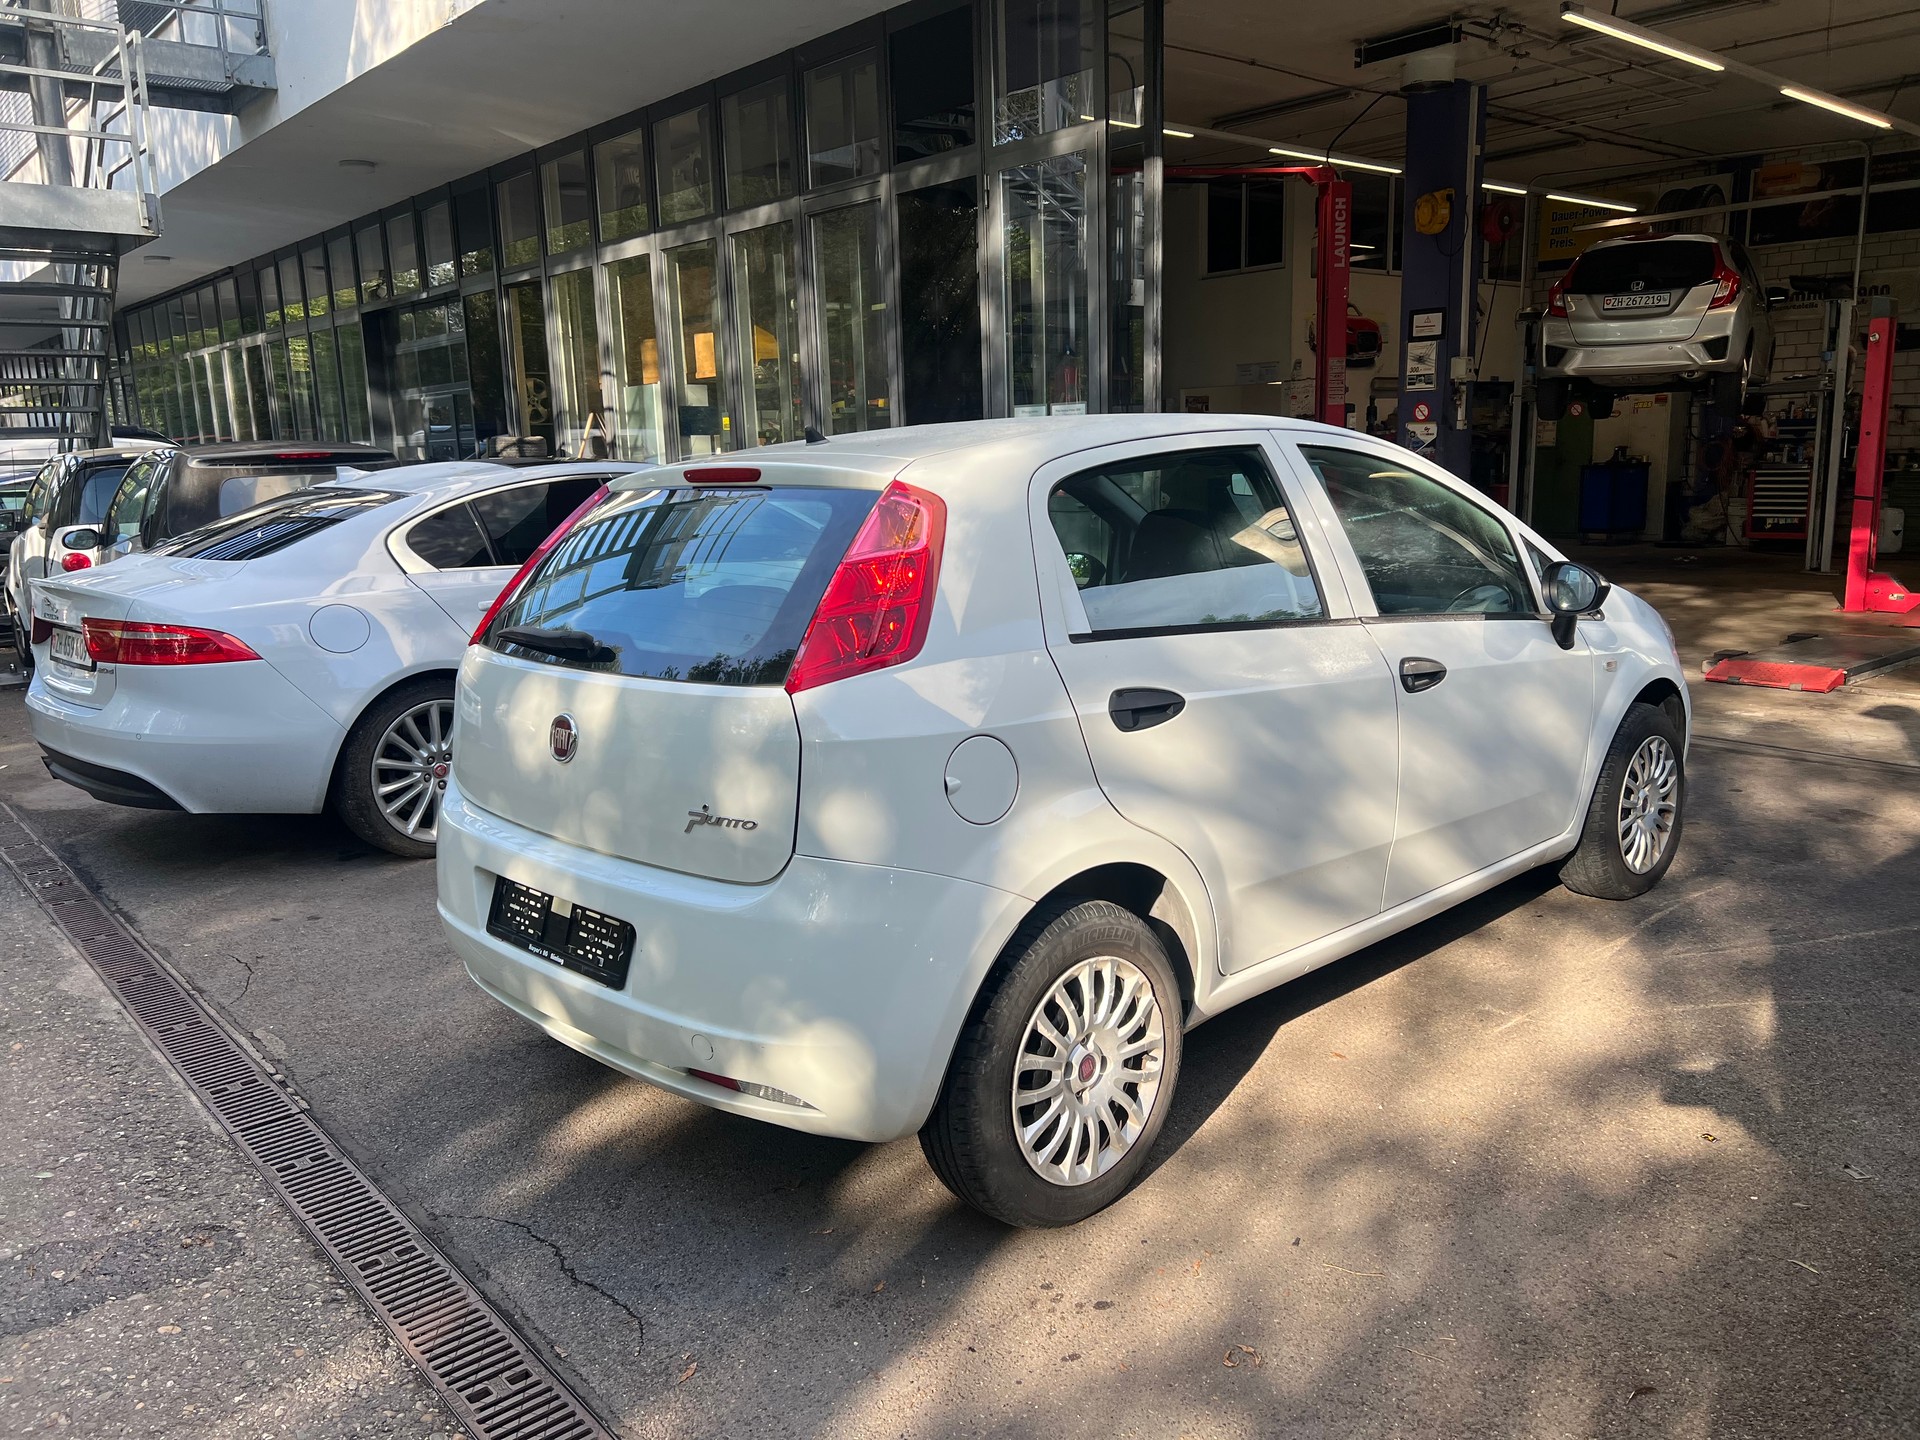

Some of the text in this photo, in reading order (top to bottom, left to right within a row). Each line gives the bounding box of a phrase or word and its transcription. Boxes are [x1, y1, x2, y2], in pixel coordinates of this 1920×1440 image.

[1334, 197, 1347, 268] LAUNCH
[1550, 225, 1569, 236] zum
[1549, 238, 1577, 249] Preis.
[1071, 926, 1137, 949] MICHELIN
